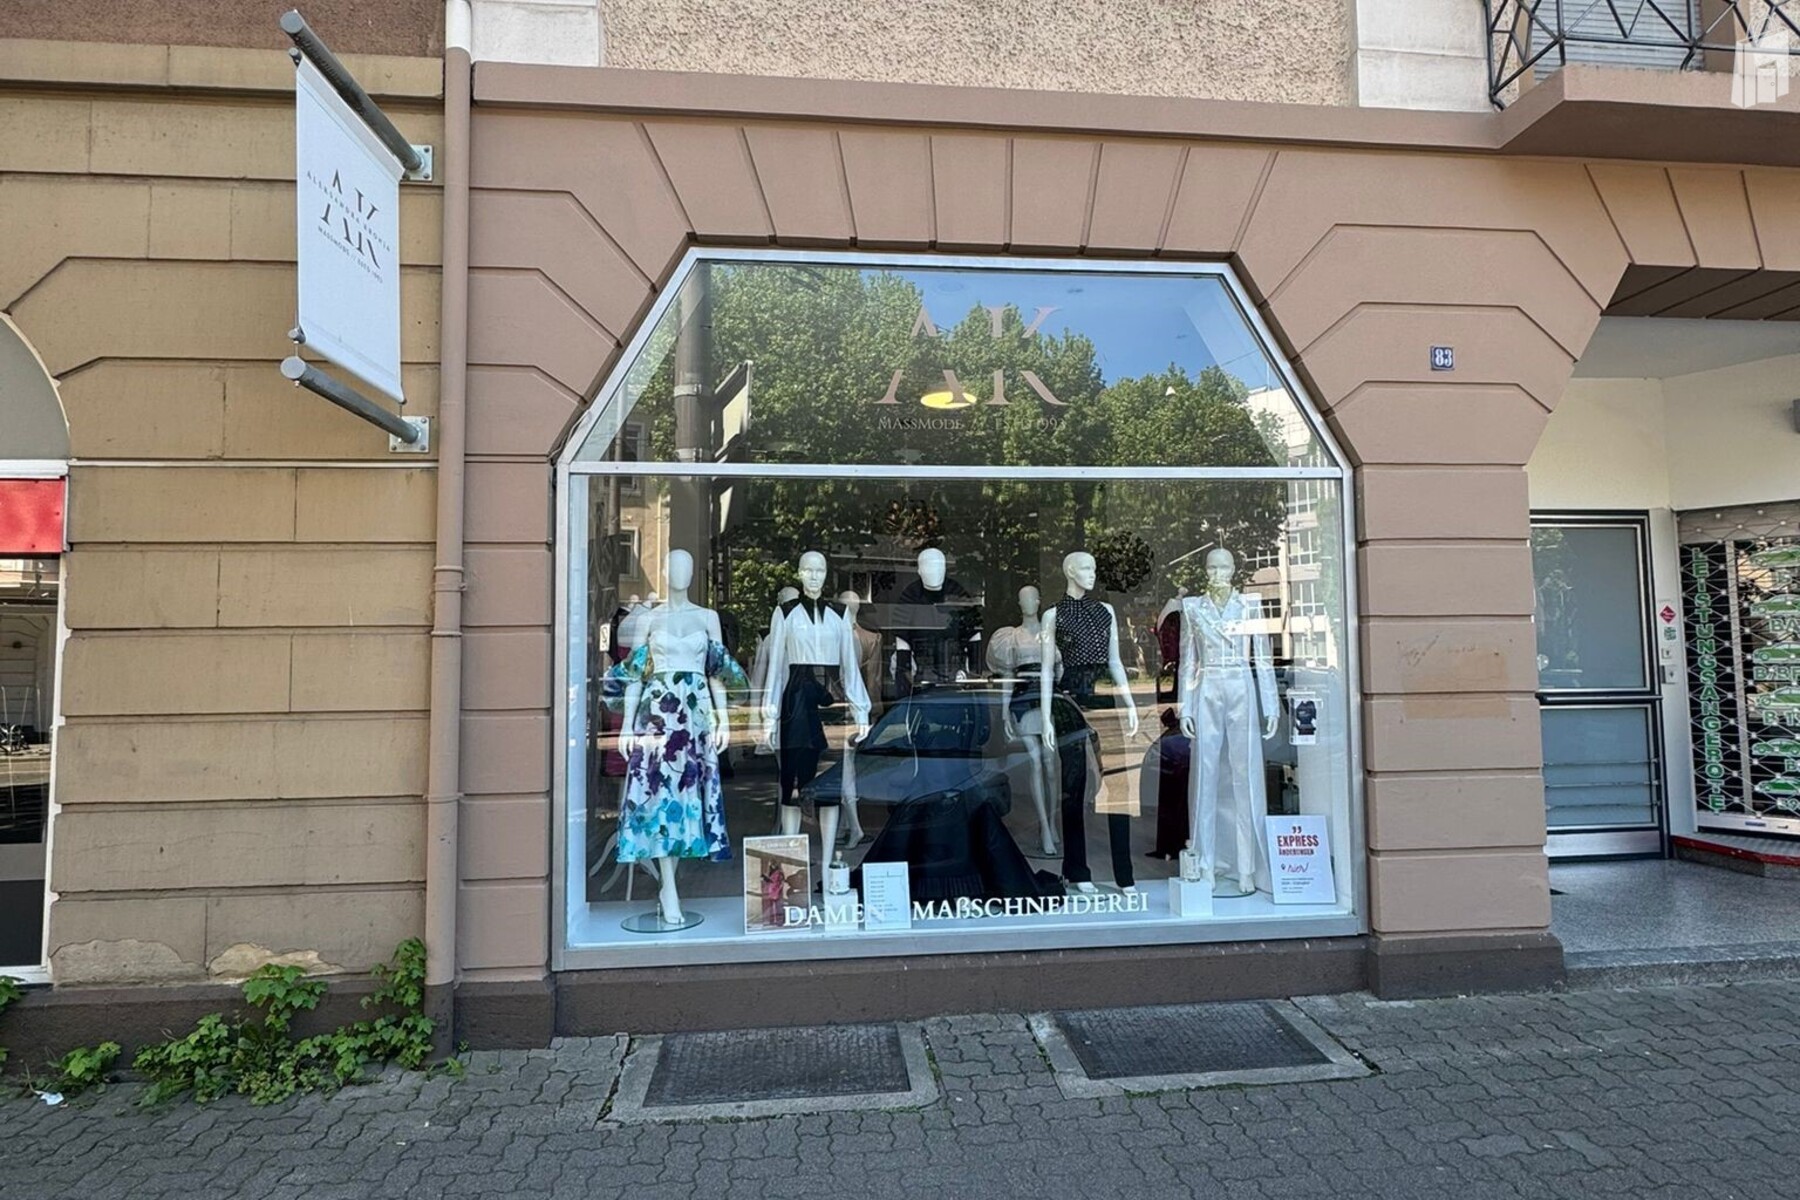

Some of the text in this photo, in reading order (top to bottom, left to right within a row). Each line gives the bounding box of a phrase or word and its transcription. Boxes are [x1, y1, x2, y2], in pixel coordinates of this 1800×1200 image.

[318, 225, 350, 256] MASSMODE
[1434, 348, 1452, 367] 83
[877, 416, 964, 431] MASSMODE
[1277, 834, 1319, 847] EXPRESS
[912, 892, 1149, 921] MAßSCHNEIDEREI
